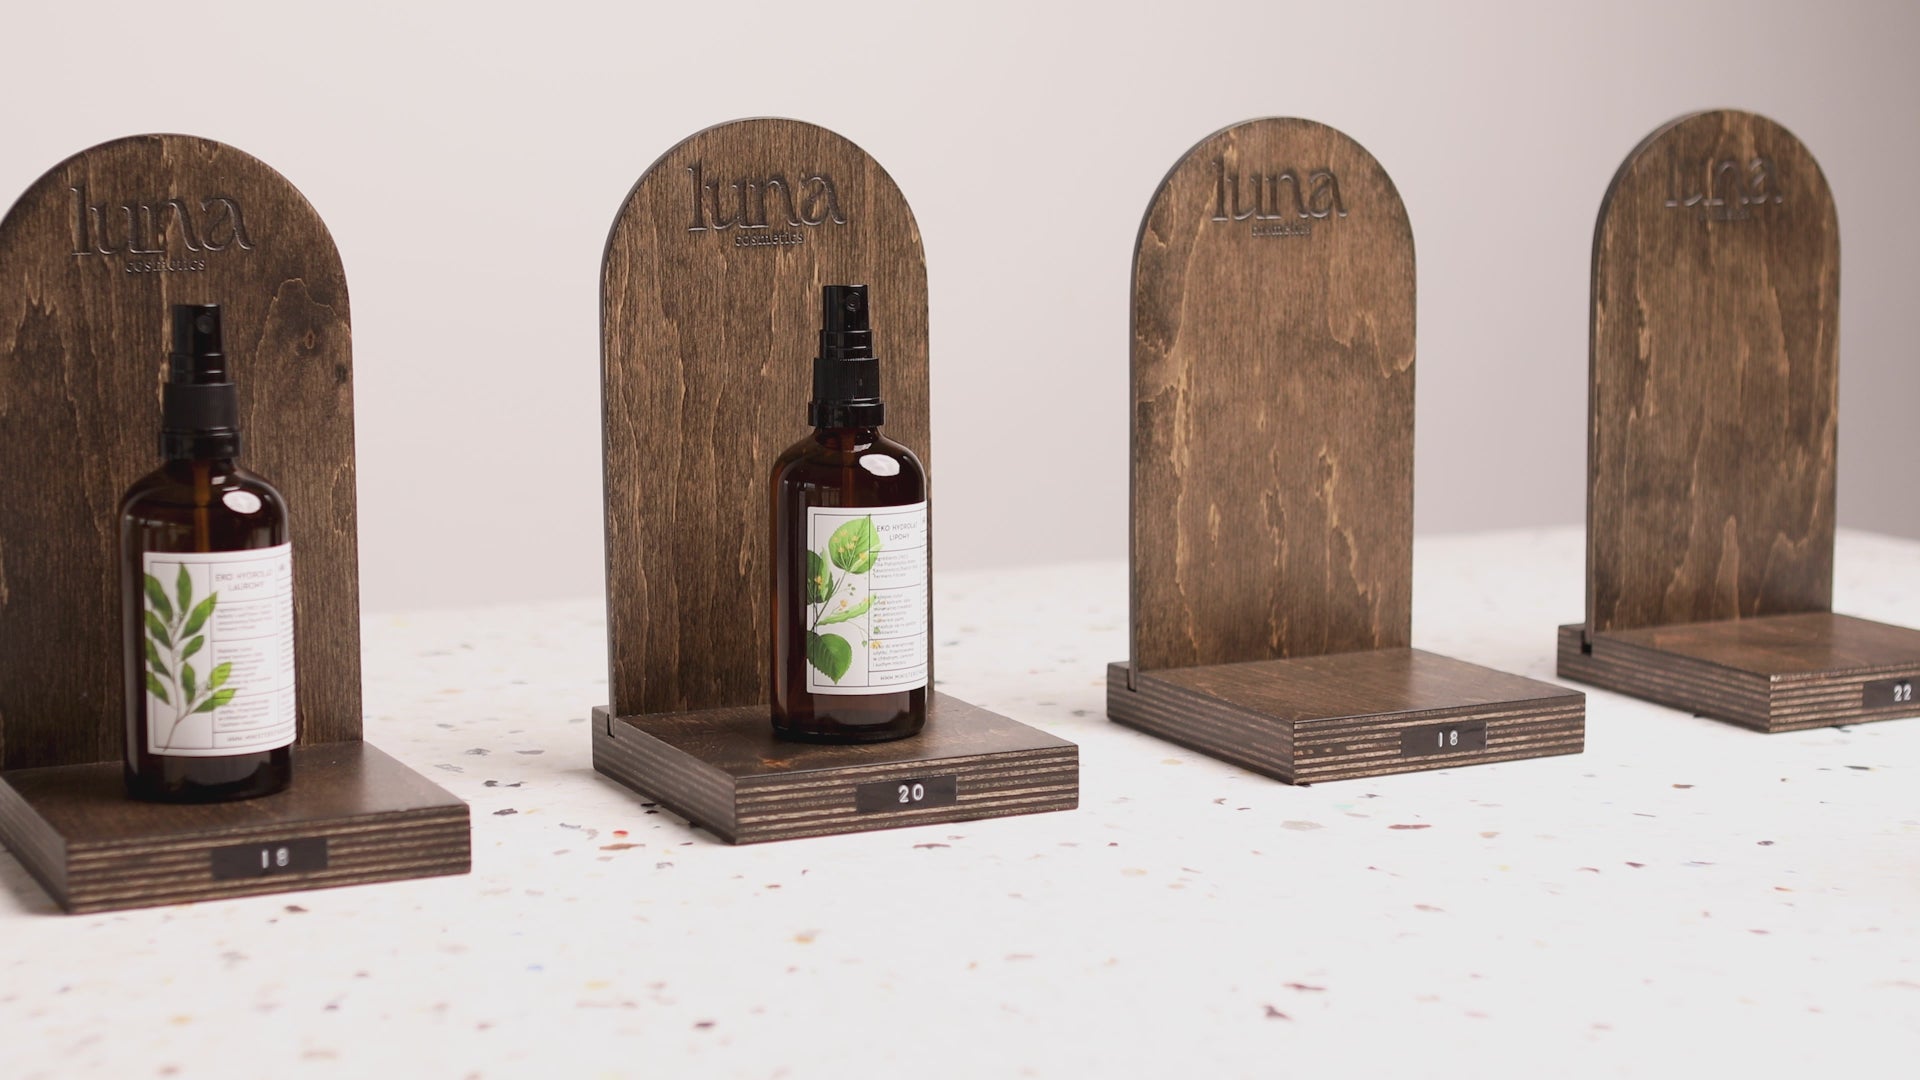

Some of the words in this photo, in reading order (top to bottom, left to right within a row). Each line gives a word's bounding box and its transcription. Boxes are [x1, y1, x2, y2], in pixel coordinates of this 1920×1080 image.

[687, 161, 848, 232] luna
[1212, 154, 1347, 221] luna
[70, 182, 256, 256] luna
[735, 231, 804, 247] cosmetics
[126, 257, 206, 273] cosmetics
[876, 524, 890, 533] EKO
[215, 573, 233, 582] EKO
[1893, 684, 1912, 702] 22
[1438, 730, 1459, 749] 18
[898, 783, 924, 803] 20
[262, 847, 290, 869] 18
